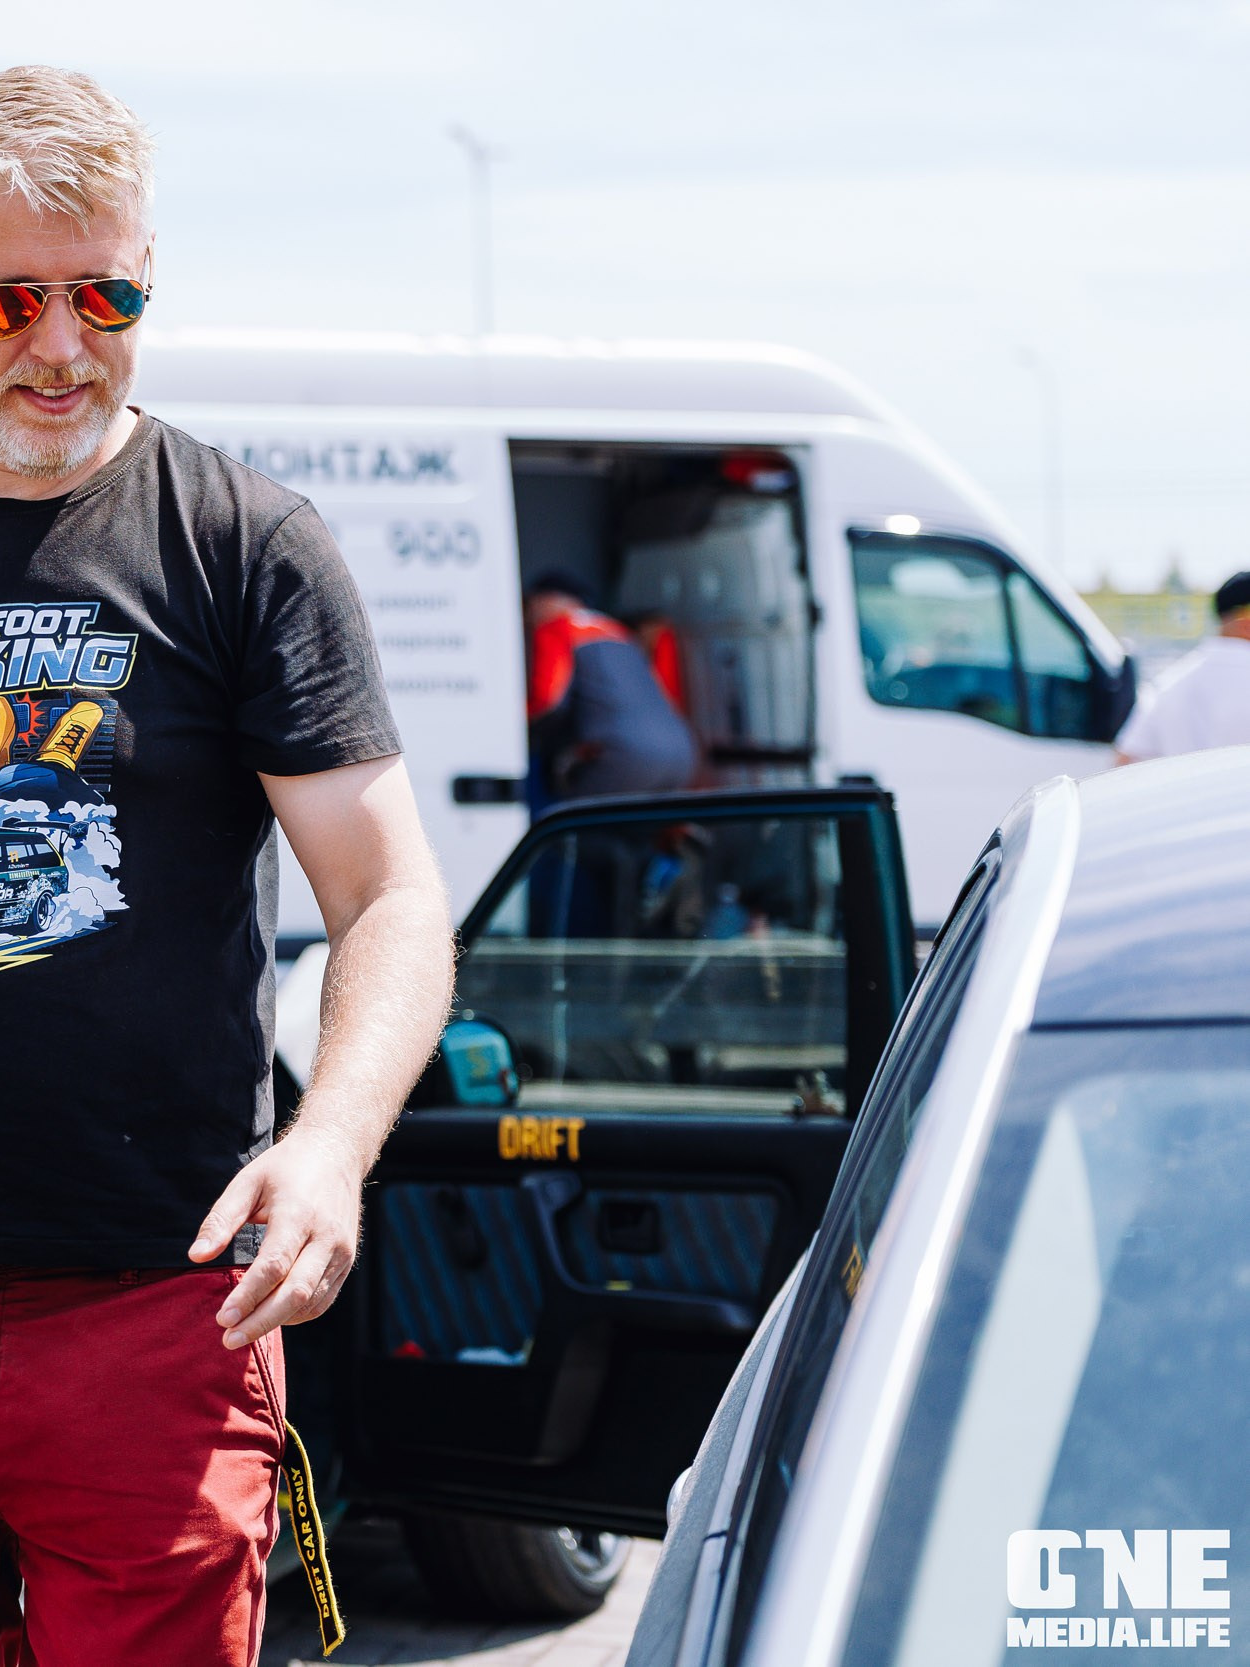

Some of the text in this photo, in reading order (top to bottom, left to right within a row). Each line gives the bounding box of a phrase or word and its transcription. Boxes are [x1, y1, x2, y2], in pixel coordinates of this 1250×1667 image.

[498, 1115, 585, 1161] DRIFT
[290, 1467, 331, 1619] DRIFT CAR ONLY
